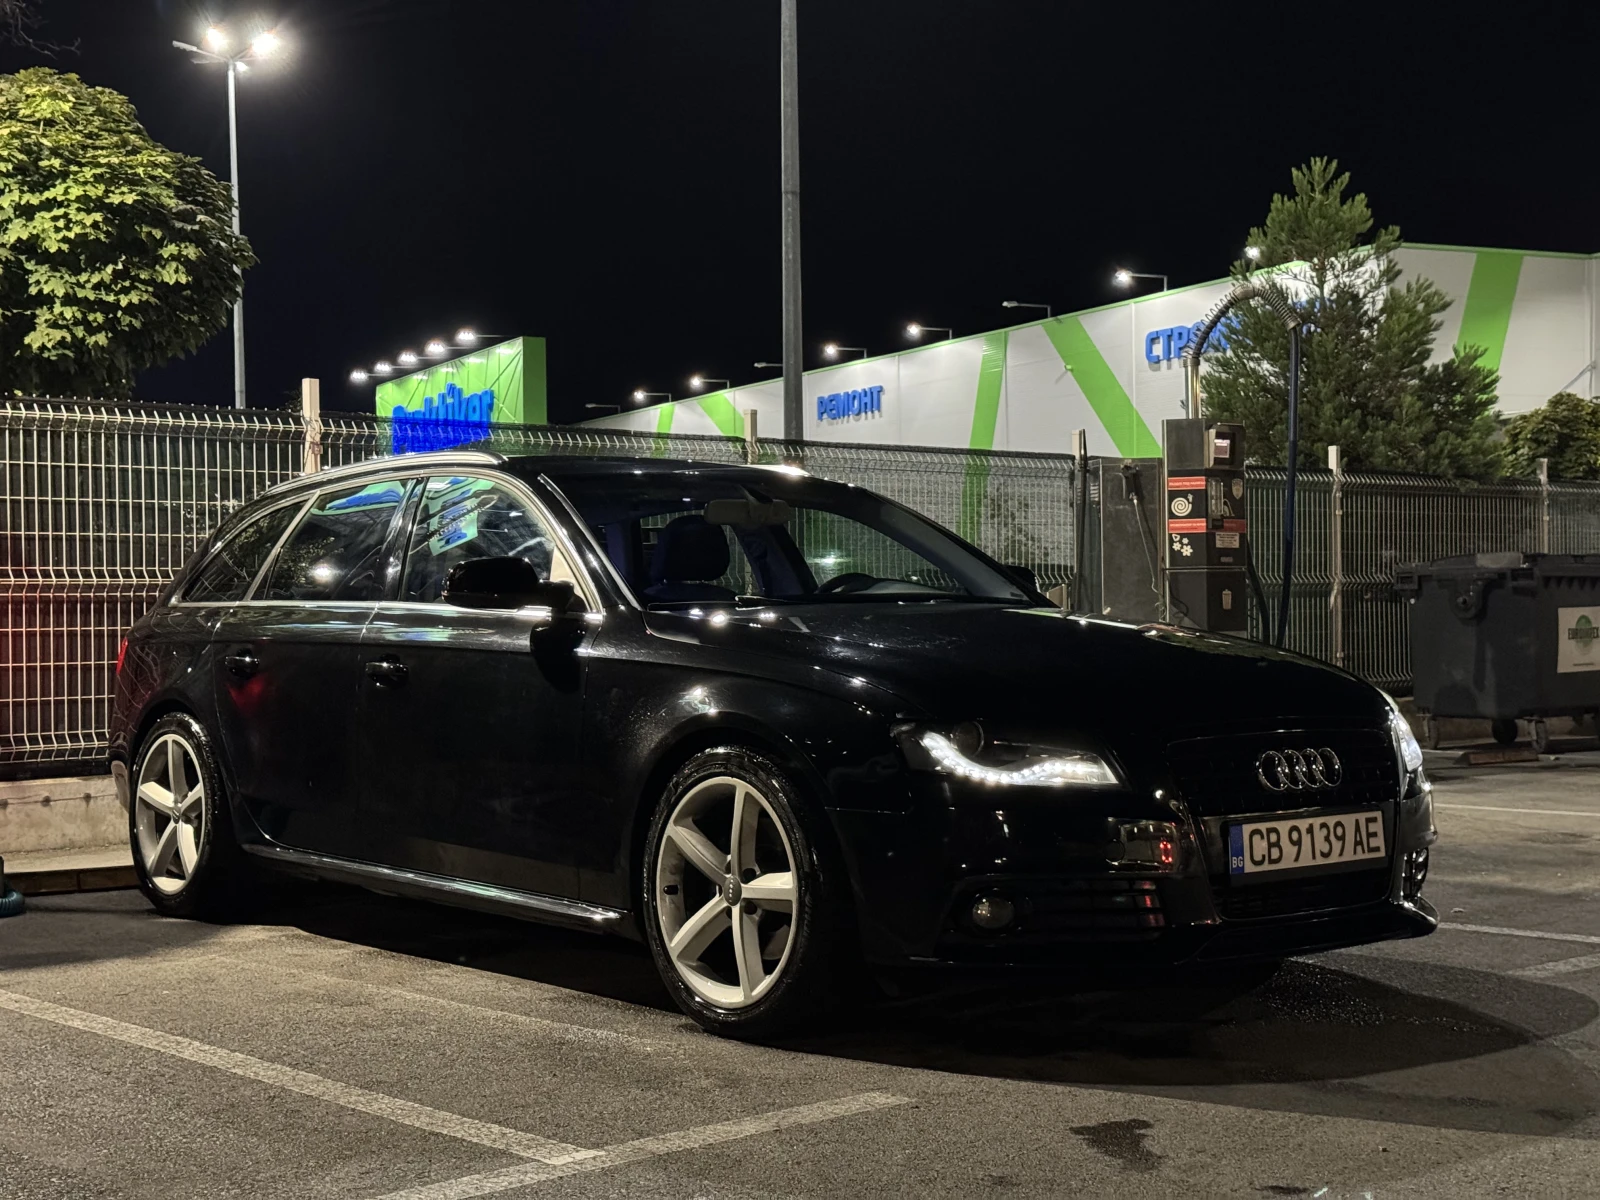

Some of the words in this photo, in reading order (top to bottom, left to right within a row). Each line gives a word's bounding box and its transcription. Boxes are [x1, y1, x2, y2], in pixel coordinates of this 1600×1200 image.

[817, 385, 883, 421] РЕМОНТ
[1249, 827, 1283, 866] CB
[1288, 820, 1346, 862] 9139
[1353, 817, 1381, 855] AE
[1232, 856, 1244, 868] BG
